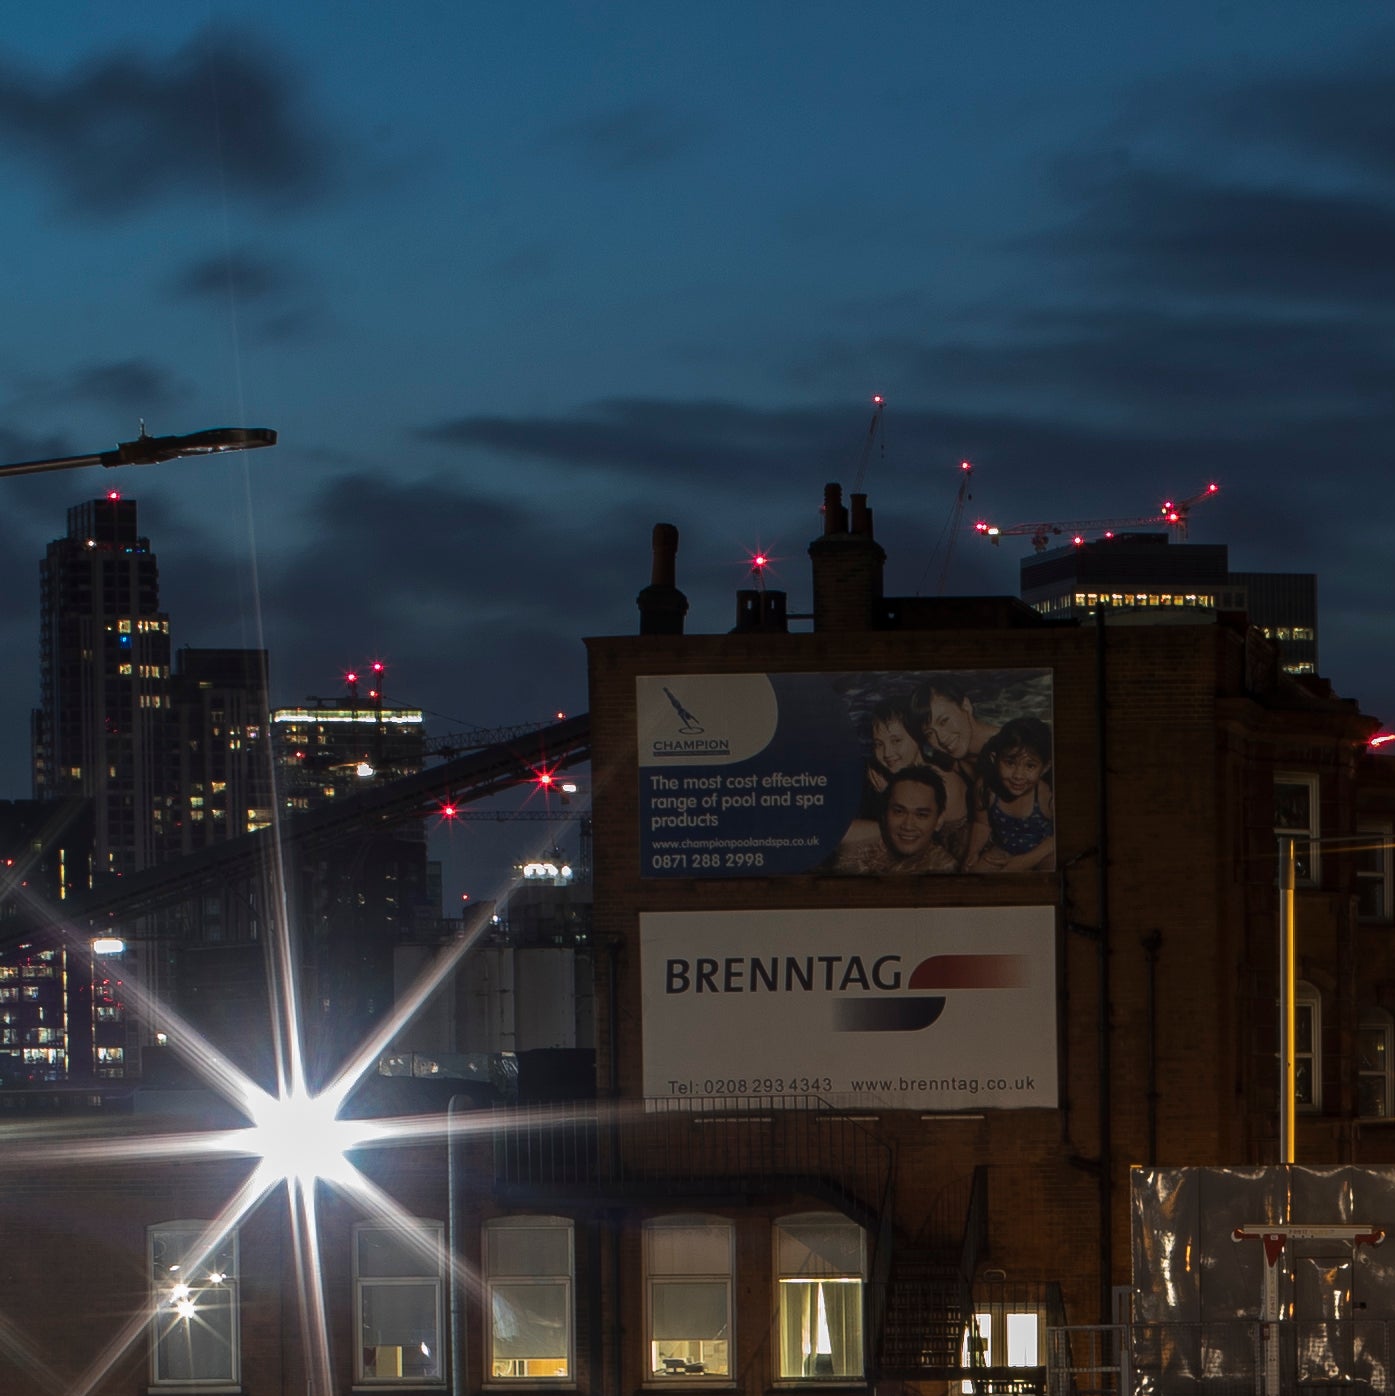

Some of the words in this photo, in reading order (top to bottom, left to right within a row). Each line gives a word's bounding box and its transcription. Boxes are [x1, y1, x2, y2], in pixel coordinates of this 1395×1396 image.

[653, 740, 729, 750] CHAMPION
[651, 776, 679, 790] The
[683, 775, 722, 789] most
[726, 774, 758, 788] cost
[762, 772, 828, 788] effective
[651, 795, 697, 812] range
[701, 793, 717, 807] of
[722, 792, 756, 811] pool
[760, 792, 791, 806] and
[795, 794, 824, 809] spa
[651, 812, 719, 831] products
[652, 836, 820, 849] www.championpoolandspa.co.uk
[653, 855, 687, 869] 0871
[692, 854, 721, 868] 288
[725, 853, 765, 867] 2998
[665, 955, 902, 994] BRENNTAG
[668, 1080, 700, 1096] Tel:
[704, 1080, 748, 1094] 0208
[752, 1079, 785, 1094] 293
[789, 1077, 833, 1092] 4343
[851, 1076, 1035, 1094] www.brenntag.co.uk
